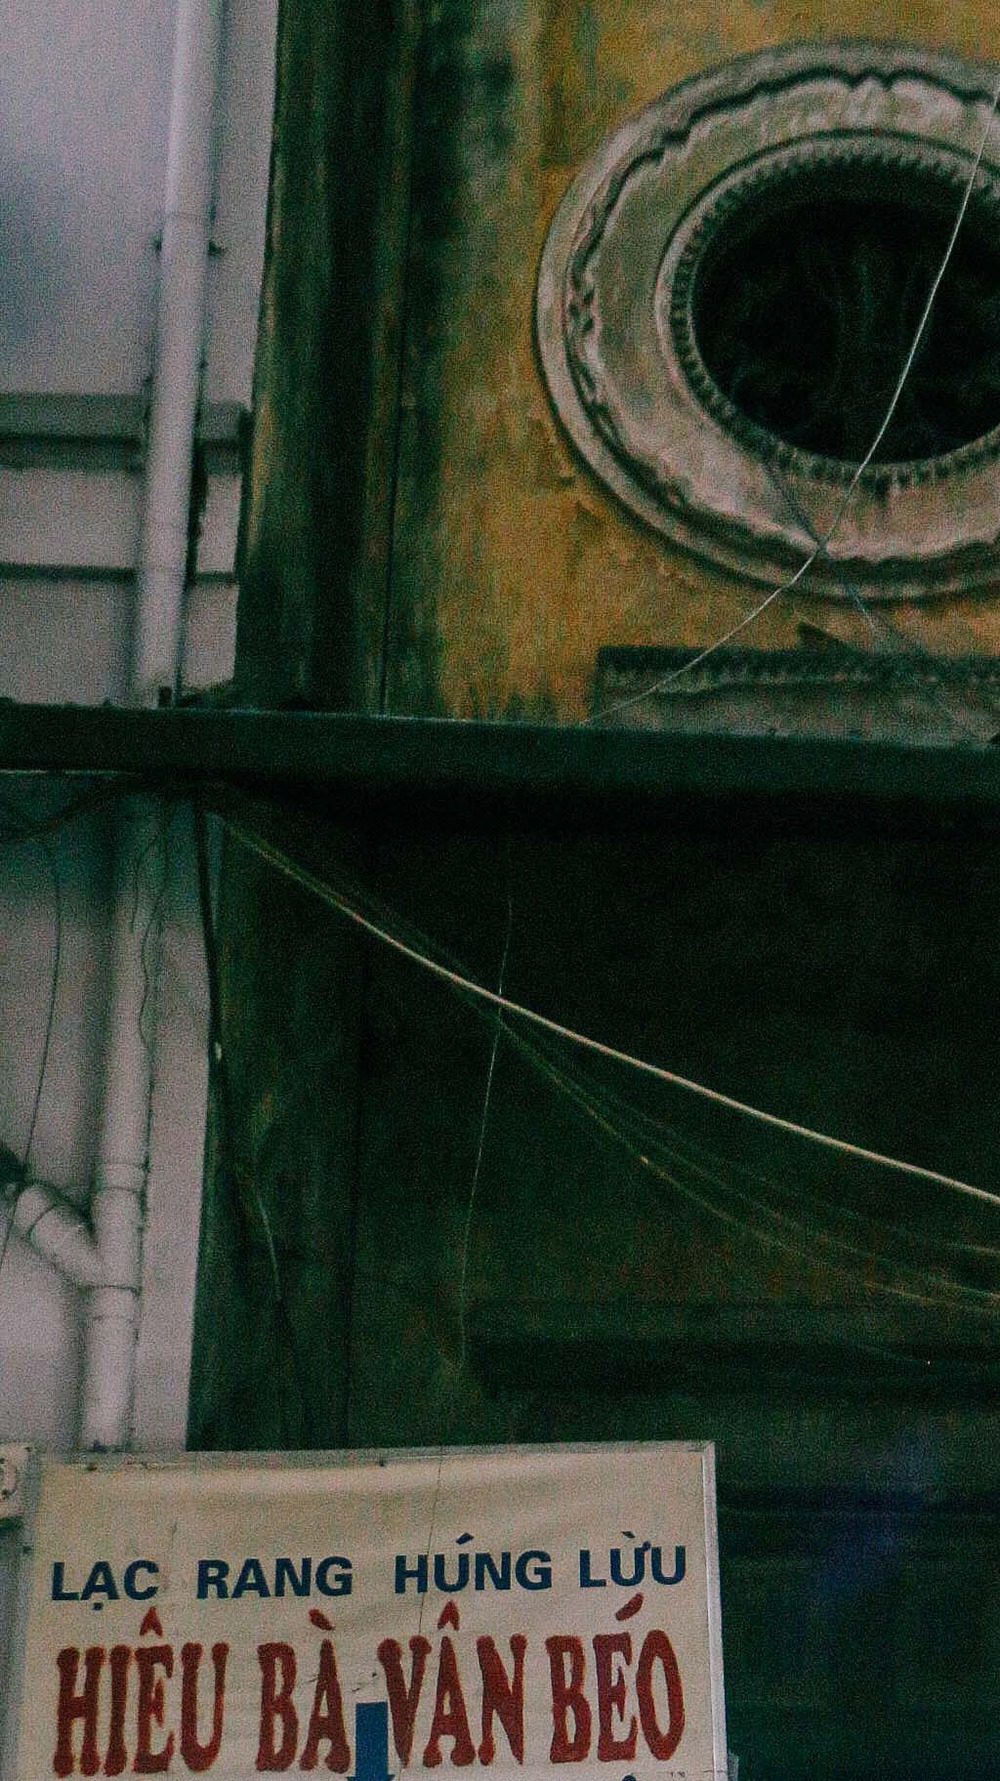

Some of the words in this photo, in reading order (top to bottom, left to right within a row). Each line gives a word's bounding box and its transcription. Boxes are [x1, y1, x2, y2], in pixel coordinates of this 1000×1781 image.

[51, 1559, 160, 1611] LẠC
[197, 1557, 352, 1599] RANG
[395, 1533, 552, 1594] HÚNG
[256, 1606, 352, 1770] BÀ
[379, 1600, 527, 1766] VÂN
[545, 1593, 685, 1762] BÉO
